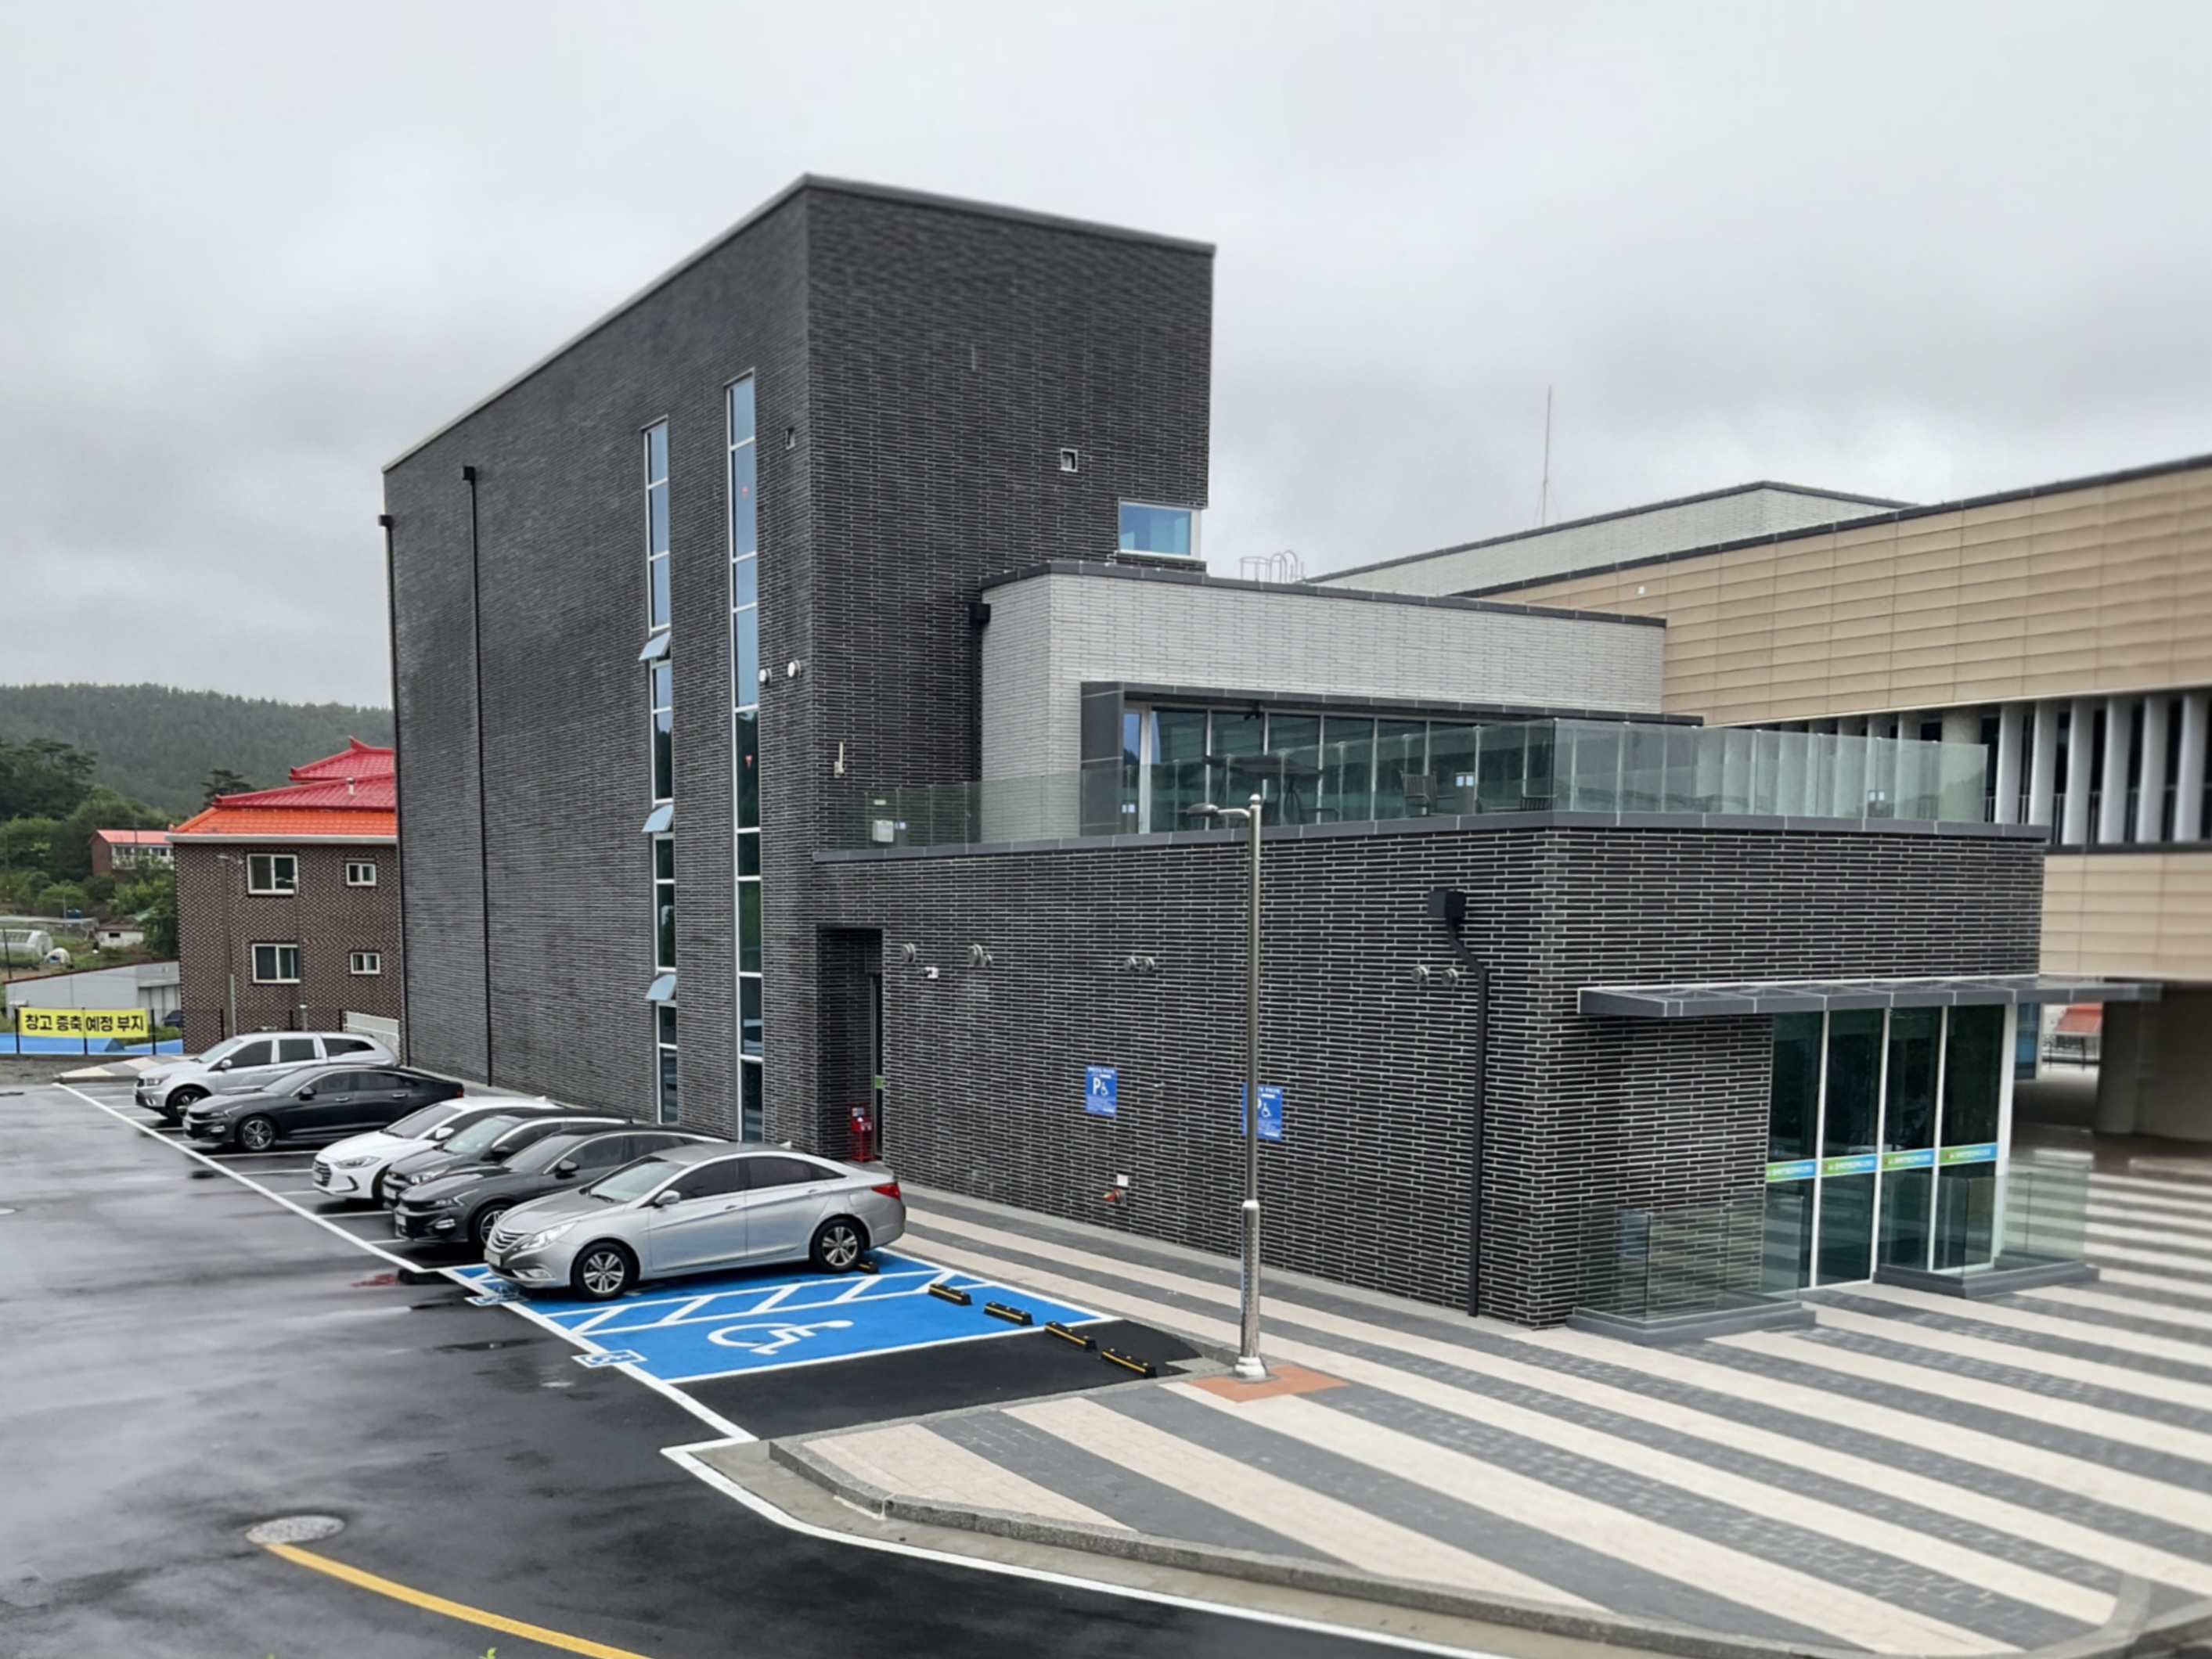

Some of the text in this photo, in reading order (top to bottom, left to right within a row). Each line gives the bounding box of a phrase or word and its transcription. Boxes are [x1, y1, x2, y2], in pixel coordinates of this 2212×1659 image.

[25, 1014, 144, 1032] 창고 증축 예정 부지
[1093, 1077, 1101, 1095] P
